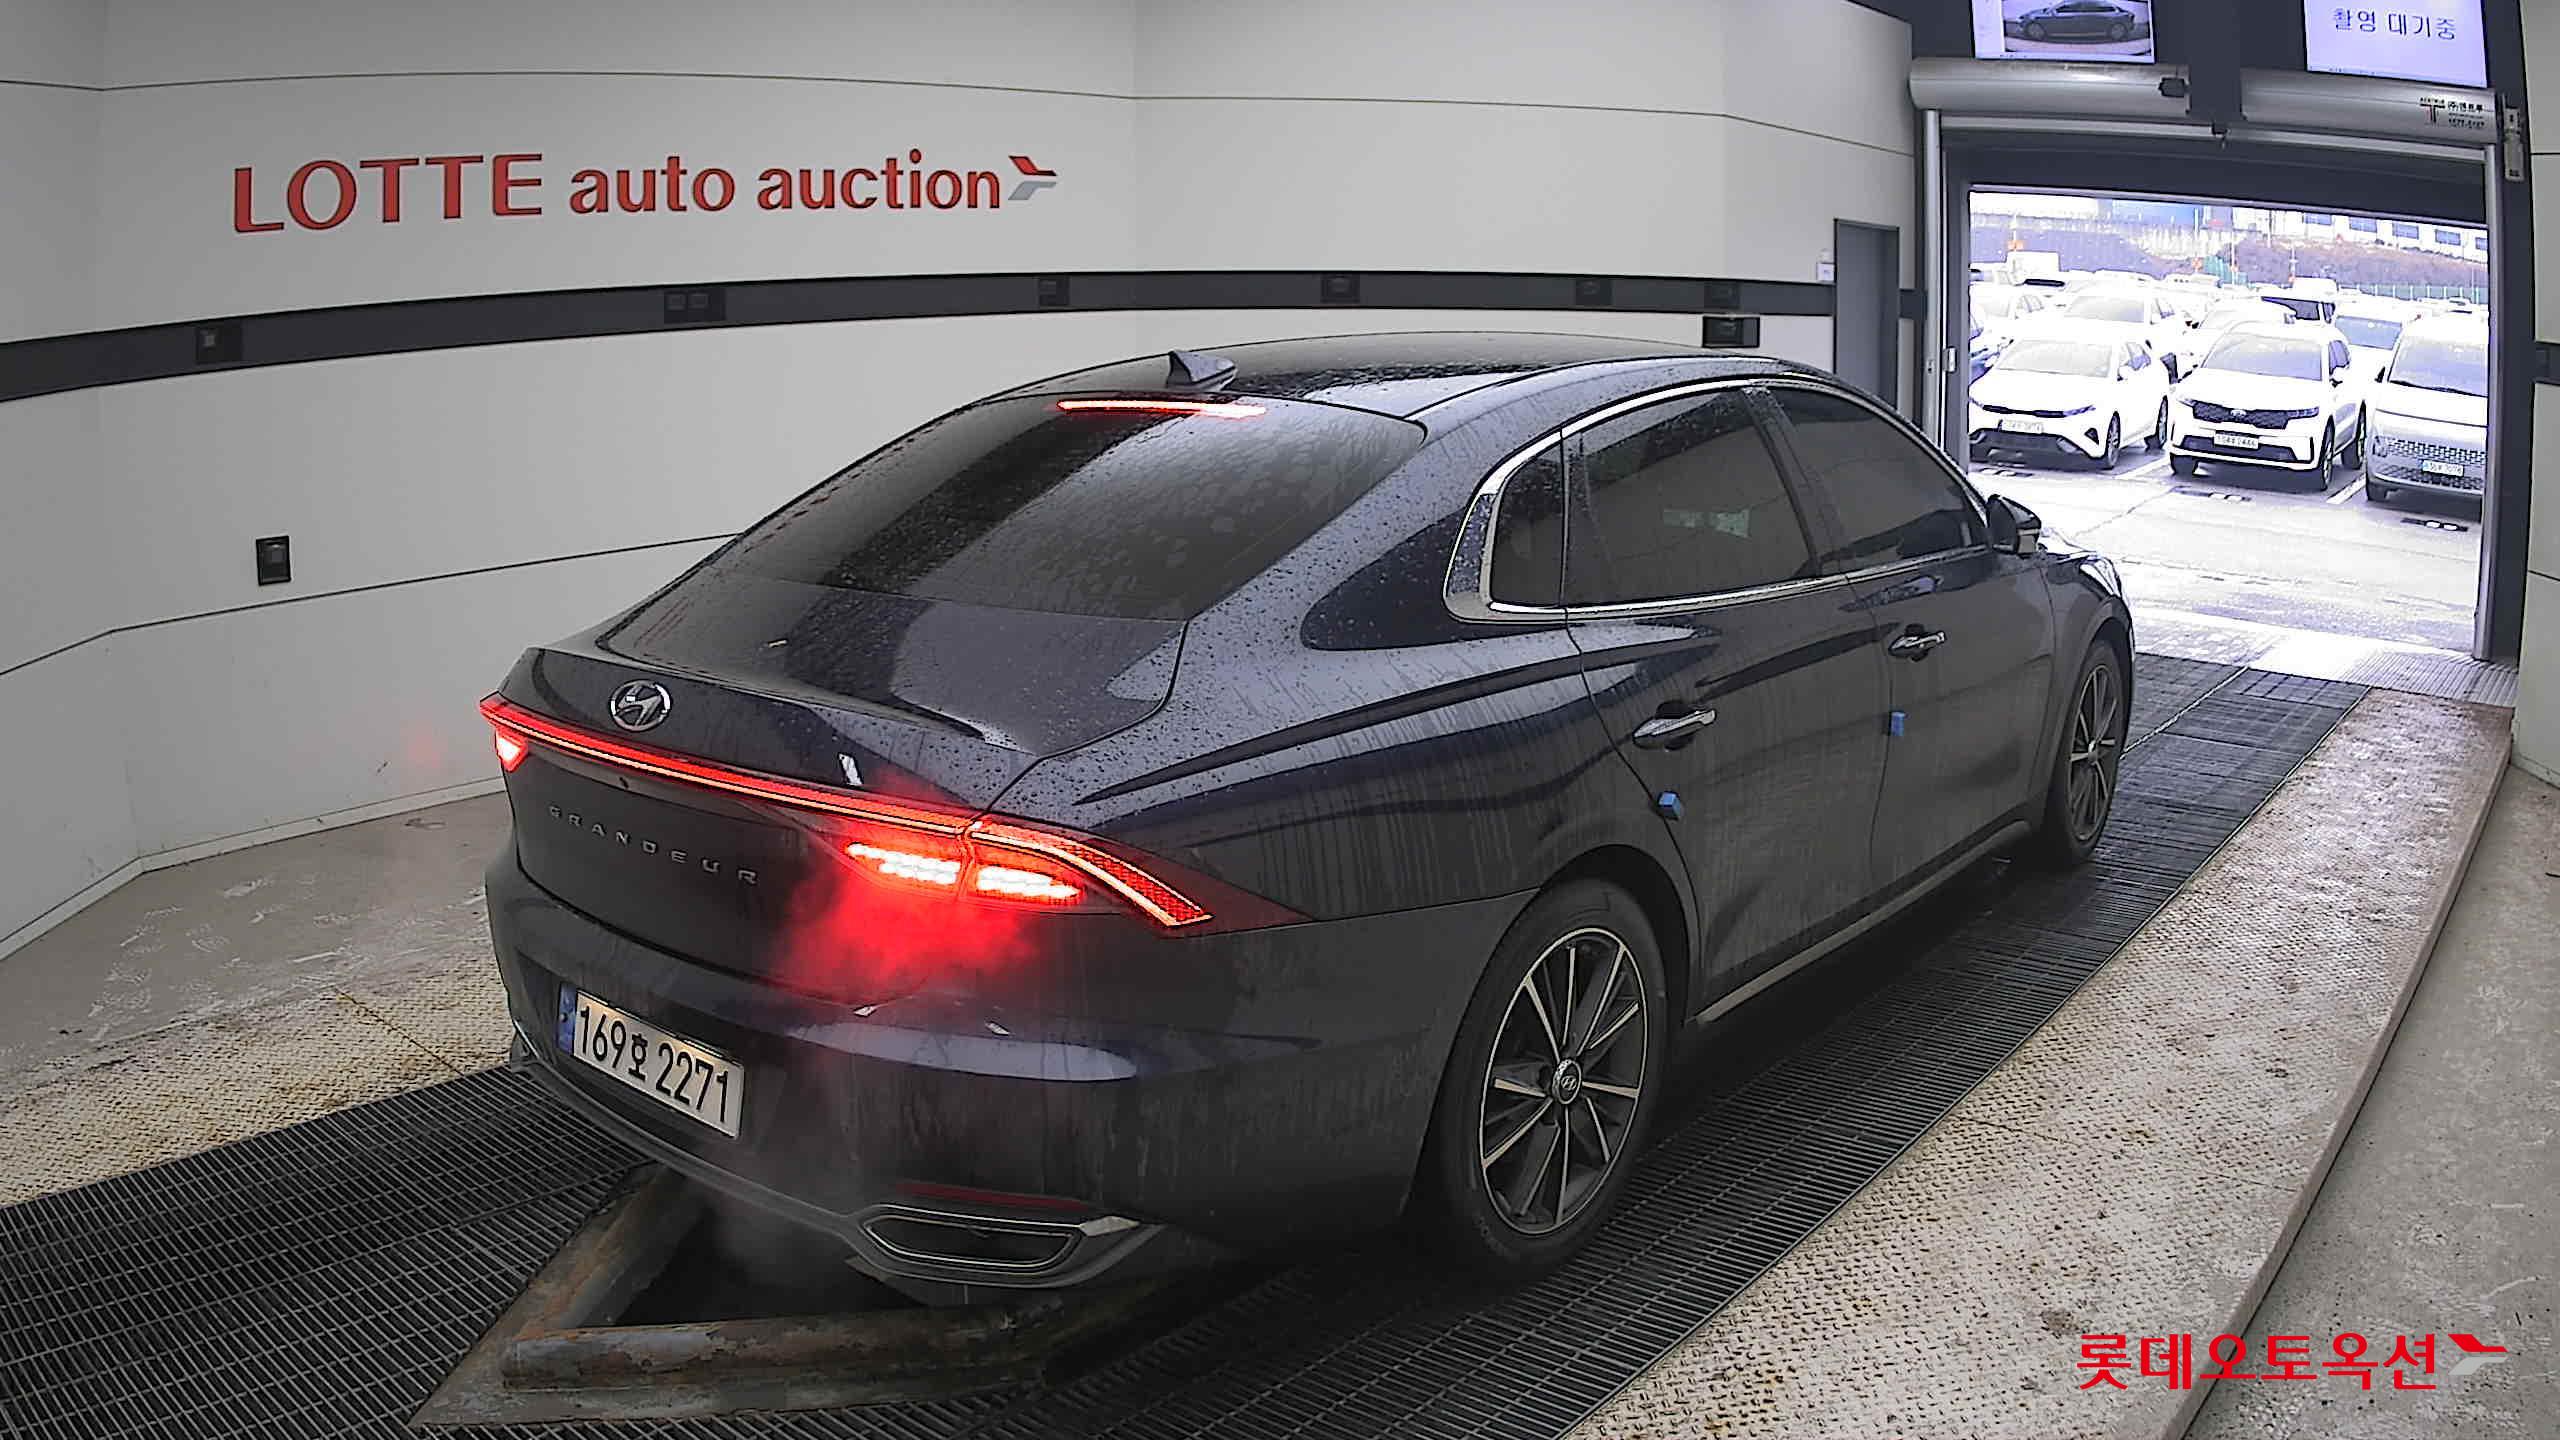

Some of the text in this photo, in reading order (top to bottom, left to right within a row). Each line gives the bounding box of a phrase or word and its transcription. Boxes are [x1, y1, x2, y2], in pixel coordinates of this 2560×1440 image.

[2333, 8, 2455, 40] 촬영 대기중
[234, 148, 1001, 233] LOTTE auto auction
[549, 804, 759, 885] GRANDEUR
[580, 1005, 729, 1123] 169호 2271
